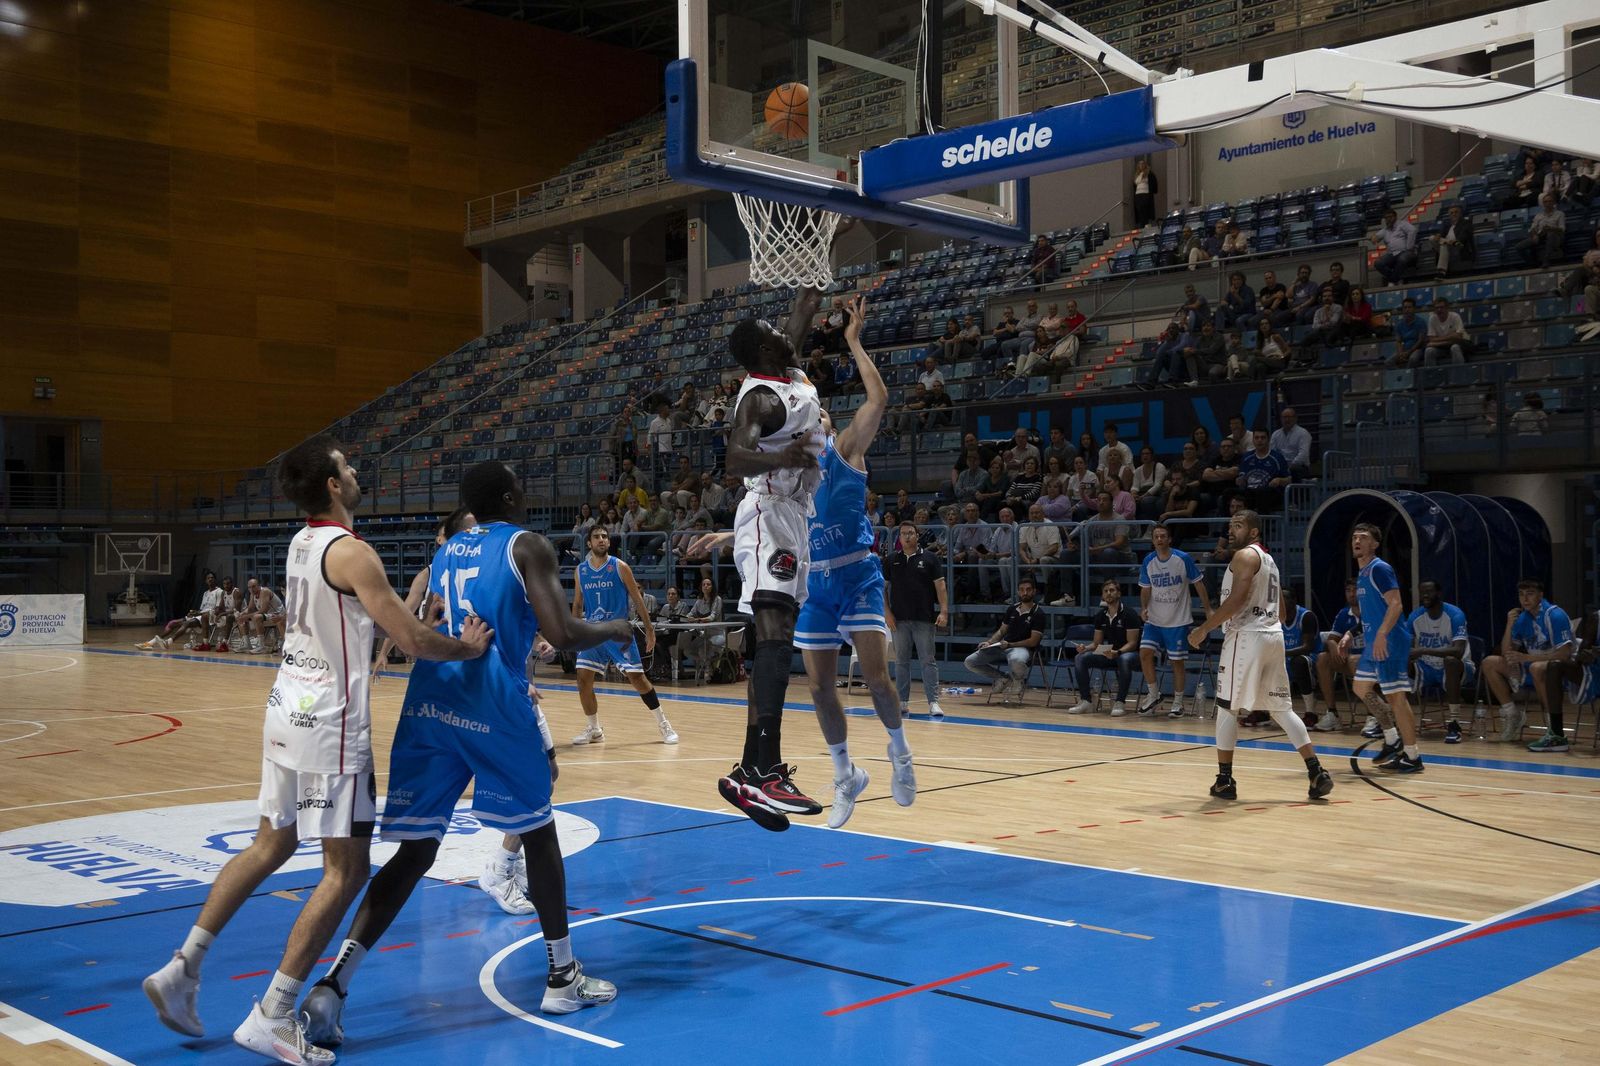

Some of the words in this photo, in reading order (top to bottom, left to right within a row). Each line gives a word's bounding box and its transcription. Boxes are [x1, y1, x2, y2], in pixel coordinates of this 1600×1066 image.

[941, 122, 1053, 168] schelde
[1218, 134, 1305, 162] Ayuntamiento
[1308, 130, 1324, 144] de
[1327, 121, 1376, 141] Huelva
[1151, 575, 1182, 588] HUELVA
[1267, 573, 1278, 603] 6
[440, 566, 480, 640] 15
[595, 592, 601, 604] 1
[22, 613, 66, 621] DIPUTACIÓN
[289, 711, 318, 721] ALTUNA
[294, 720, 315, 728] URIA
[417, 703, 490, 733] Abndancia
[9, 840, 205, 893] HUELVA
